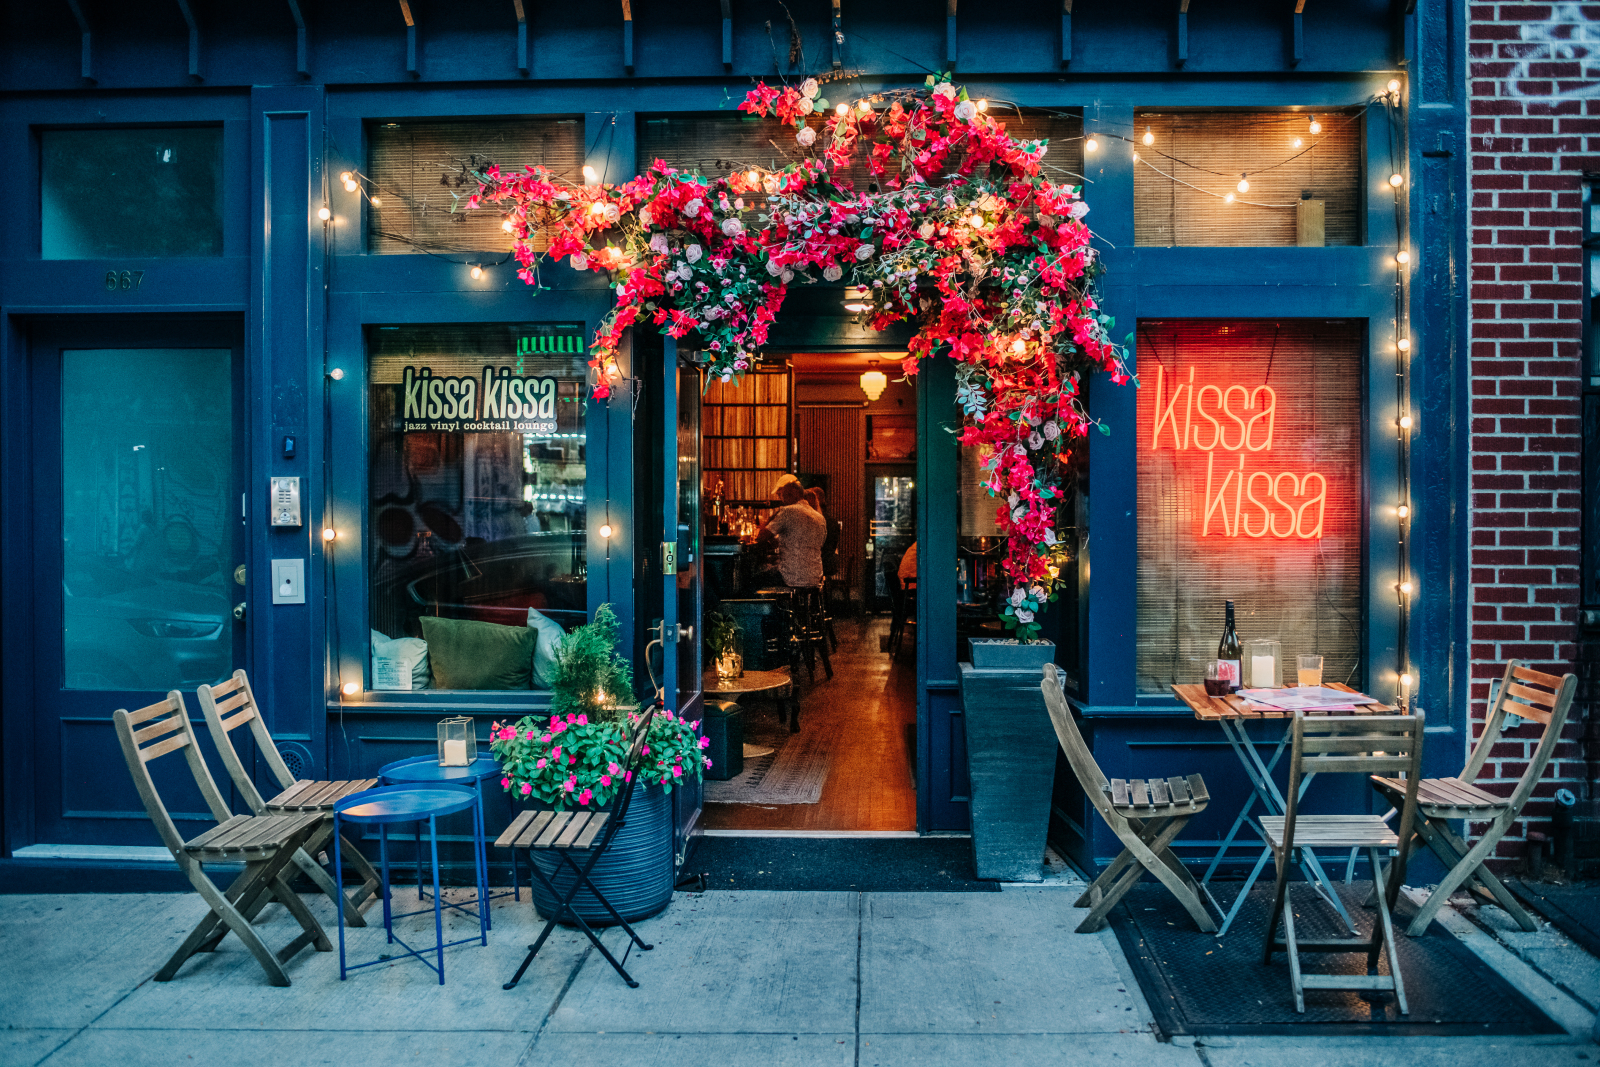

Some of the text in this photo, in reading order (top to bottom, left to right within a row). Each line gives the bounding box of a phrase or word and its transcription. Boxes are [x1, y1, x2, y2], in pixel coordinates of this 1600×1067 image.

[105, 269, 145, 291] 667
[404, 368, 556, 420] kissa kissa
[1152, 365, 1277, 451] kissa
[404, 421, 555, 433] jazz vinyl cocktail lounge
[1202, 451, 1327, 539] kissa
